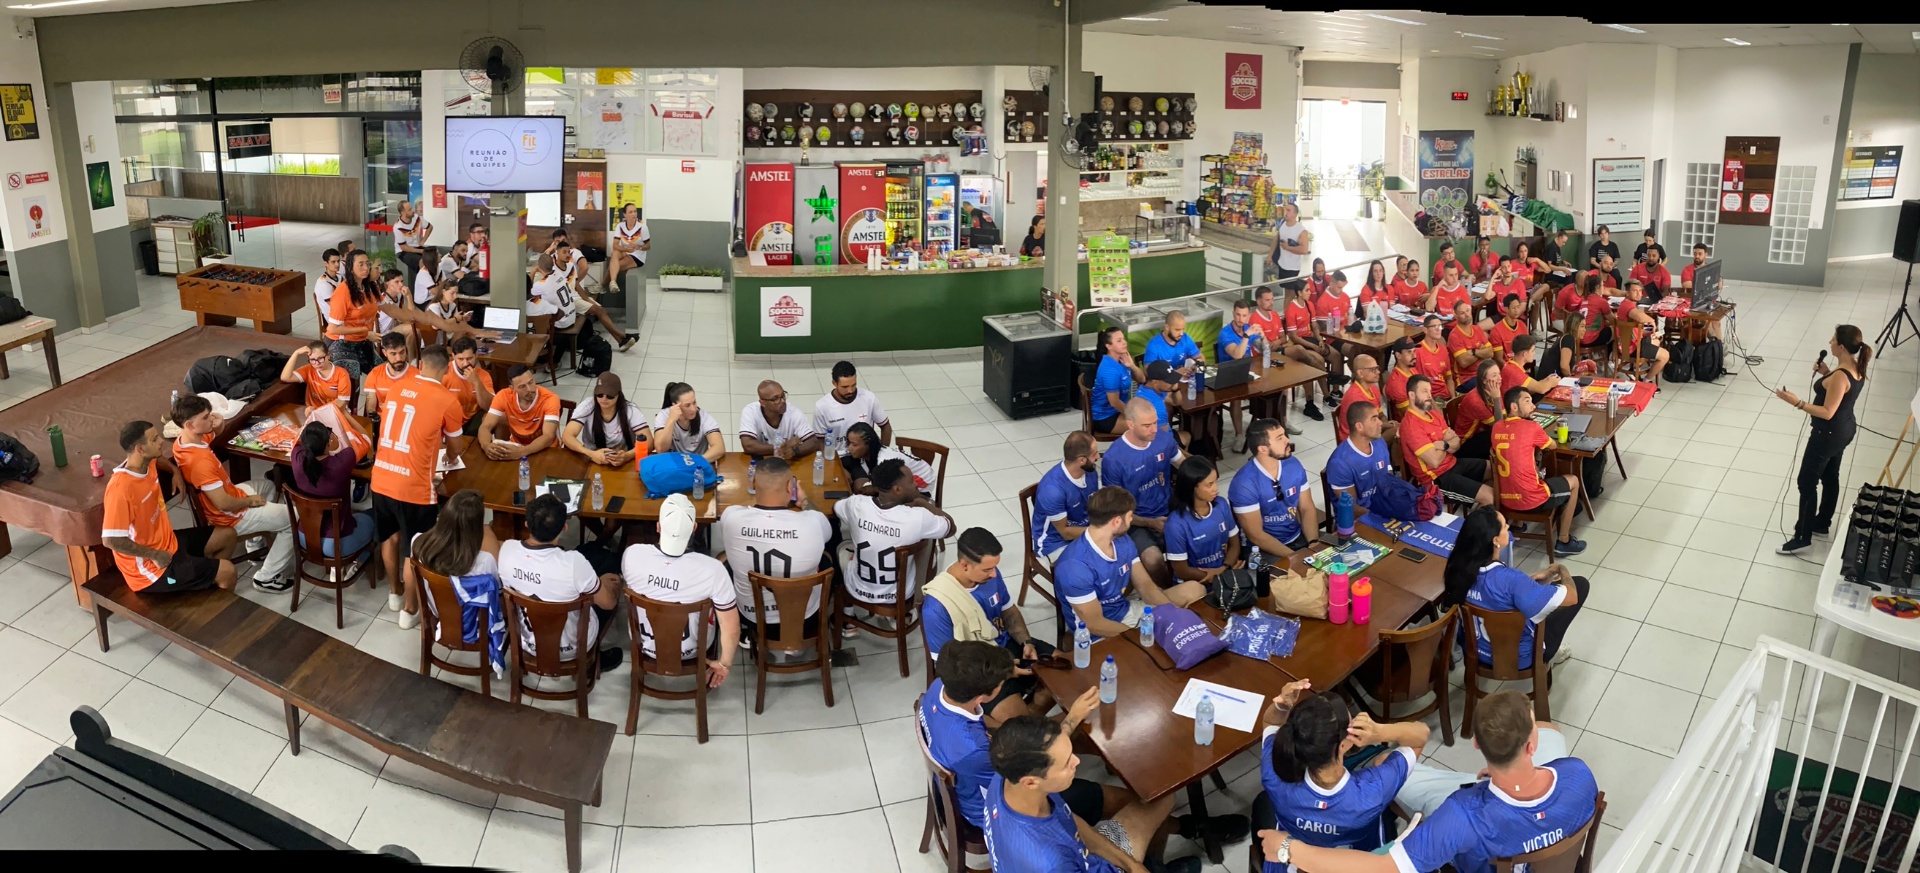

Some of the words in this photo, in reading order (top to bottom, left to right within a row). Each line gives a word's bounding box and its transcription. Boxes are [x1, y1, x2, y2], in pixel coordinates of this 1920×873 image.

[1232, 77, 1257, 86] SOCCER
[324, 89, 340, 100] SAÍDA
[229, 137, 253, 147] SALA
[255, 135, 270, 145] VIP
[522, 134, 537, 147] fit
[749, 170, 791, 182] AMSTEL
[1422, 168, 1470, 179] ESTRELAS
[767, 253, 788, 261] LAGER
[769, 308, 803, 316] SOCCER
[400, 388, 418, 399] BION
[380, 400, 415, 453] 11
[1496, 442, 1510, 478] 5
[741, 526, 799, 539] GUILHERME
[858, 518, 901, 538] LEONARDO
[1407, 529, 1456, 551] smart
[746, 545, 792, 578] 10
[857, 540, 897, 585] 69
[513, 567, 541, 585] JONAS
[647, 574, 680, 591] PAULO
[1175, 627, 1211, 650] EXPERIENC
[1296, 817, 1341, 836] CAROL
[1522, 828, 1563, 854] VICTOR
